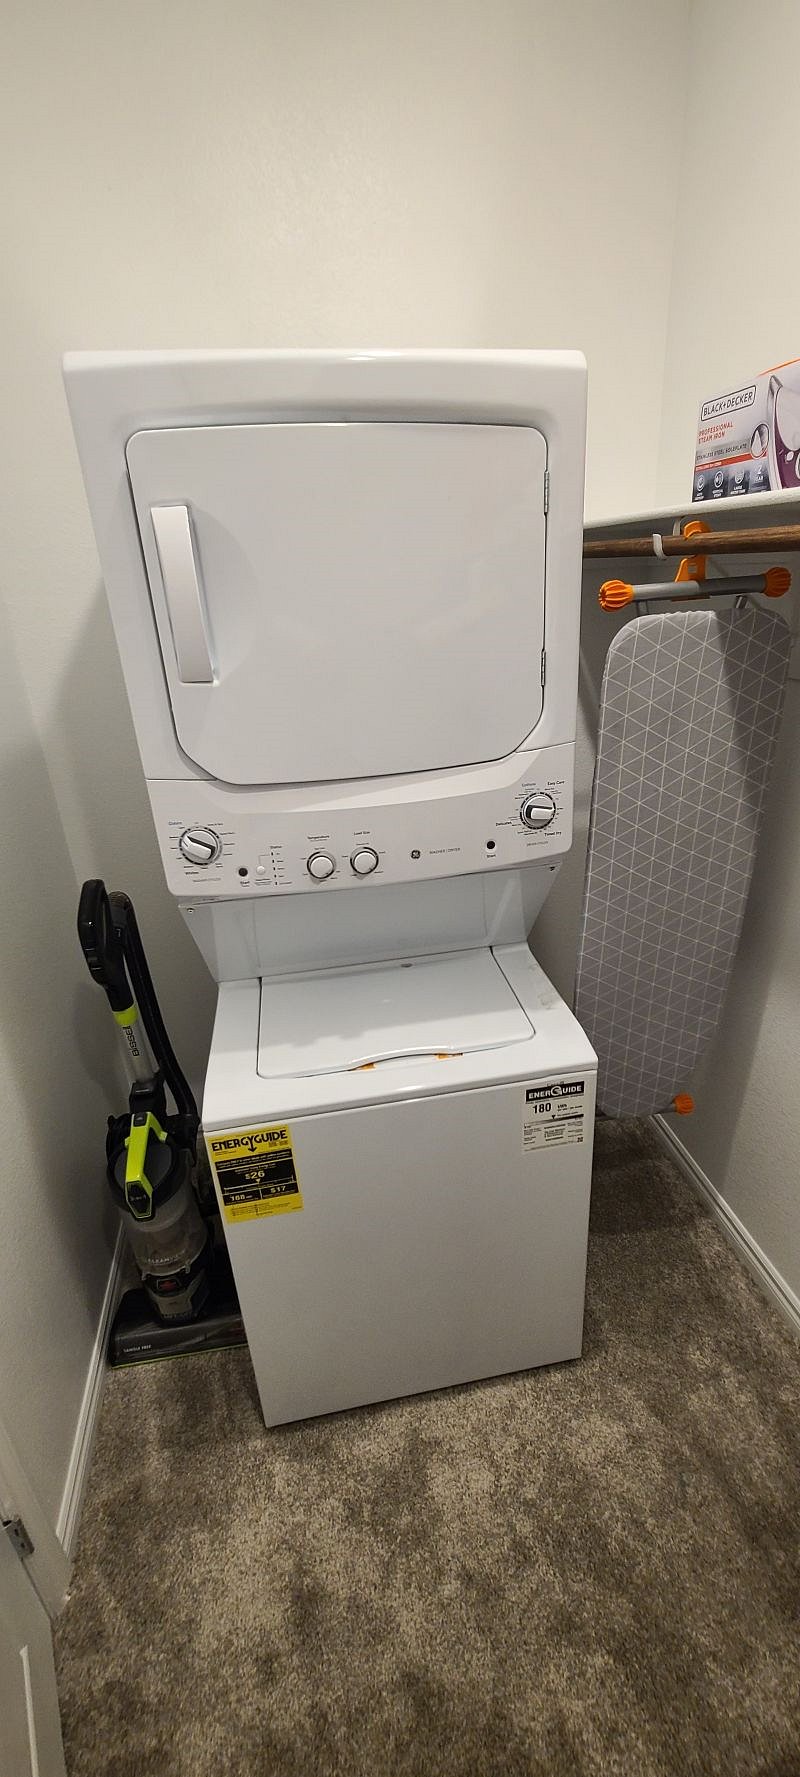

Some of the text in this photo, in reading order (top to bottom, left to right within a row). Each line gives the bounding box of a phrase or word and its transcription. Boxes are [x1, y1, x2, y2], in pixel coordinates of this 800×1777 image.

[703, 391, 754, 417] BLACK+DECKER
[698, 421, 734, 437] PROFESSIONAL
[698, 431, 726, 445] STEAM IRON
[528, 1085, 582, 1099] ENERGUIDE
[532, 1102, 552, 1114] 180
[211, 1129, 288, 1152] ENERGYGUIDE
[245, 1170, 265, 1180] $26
